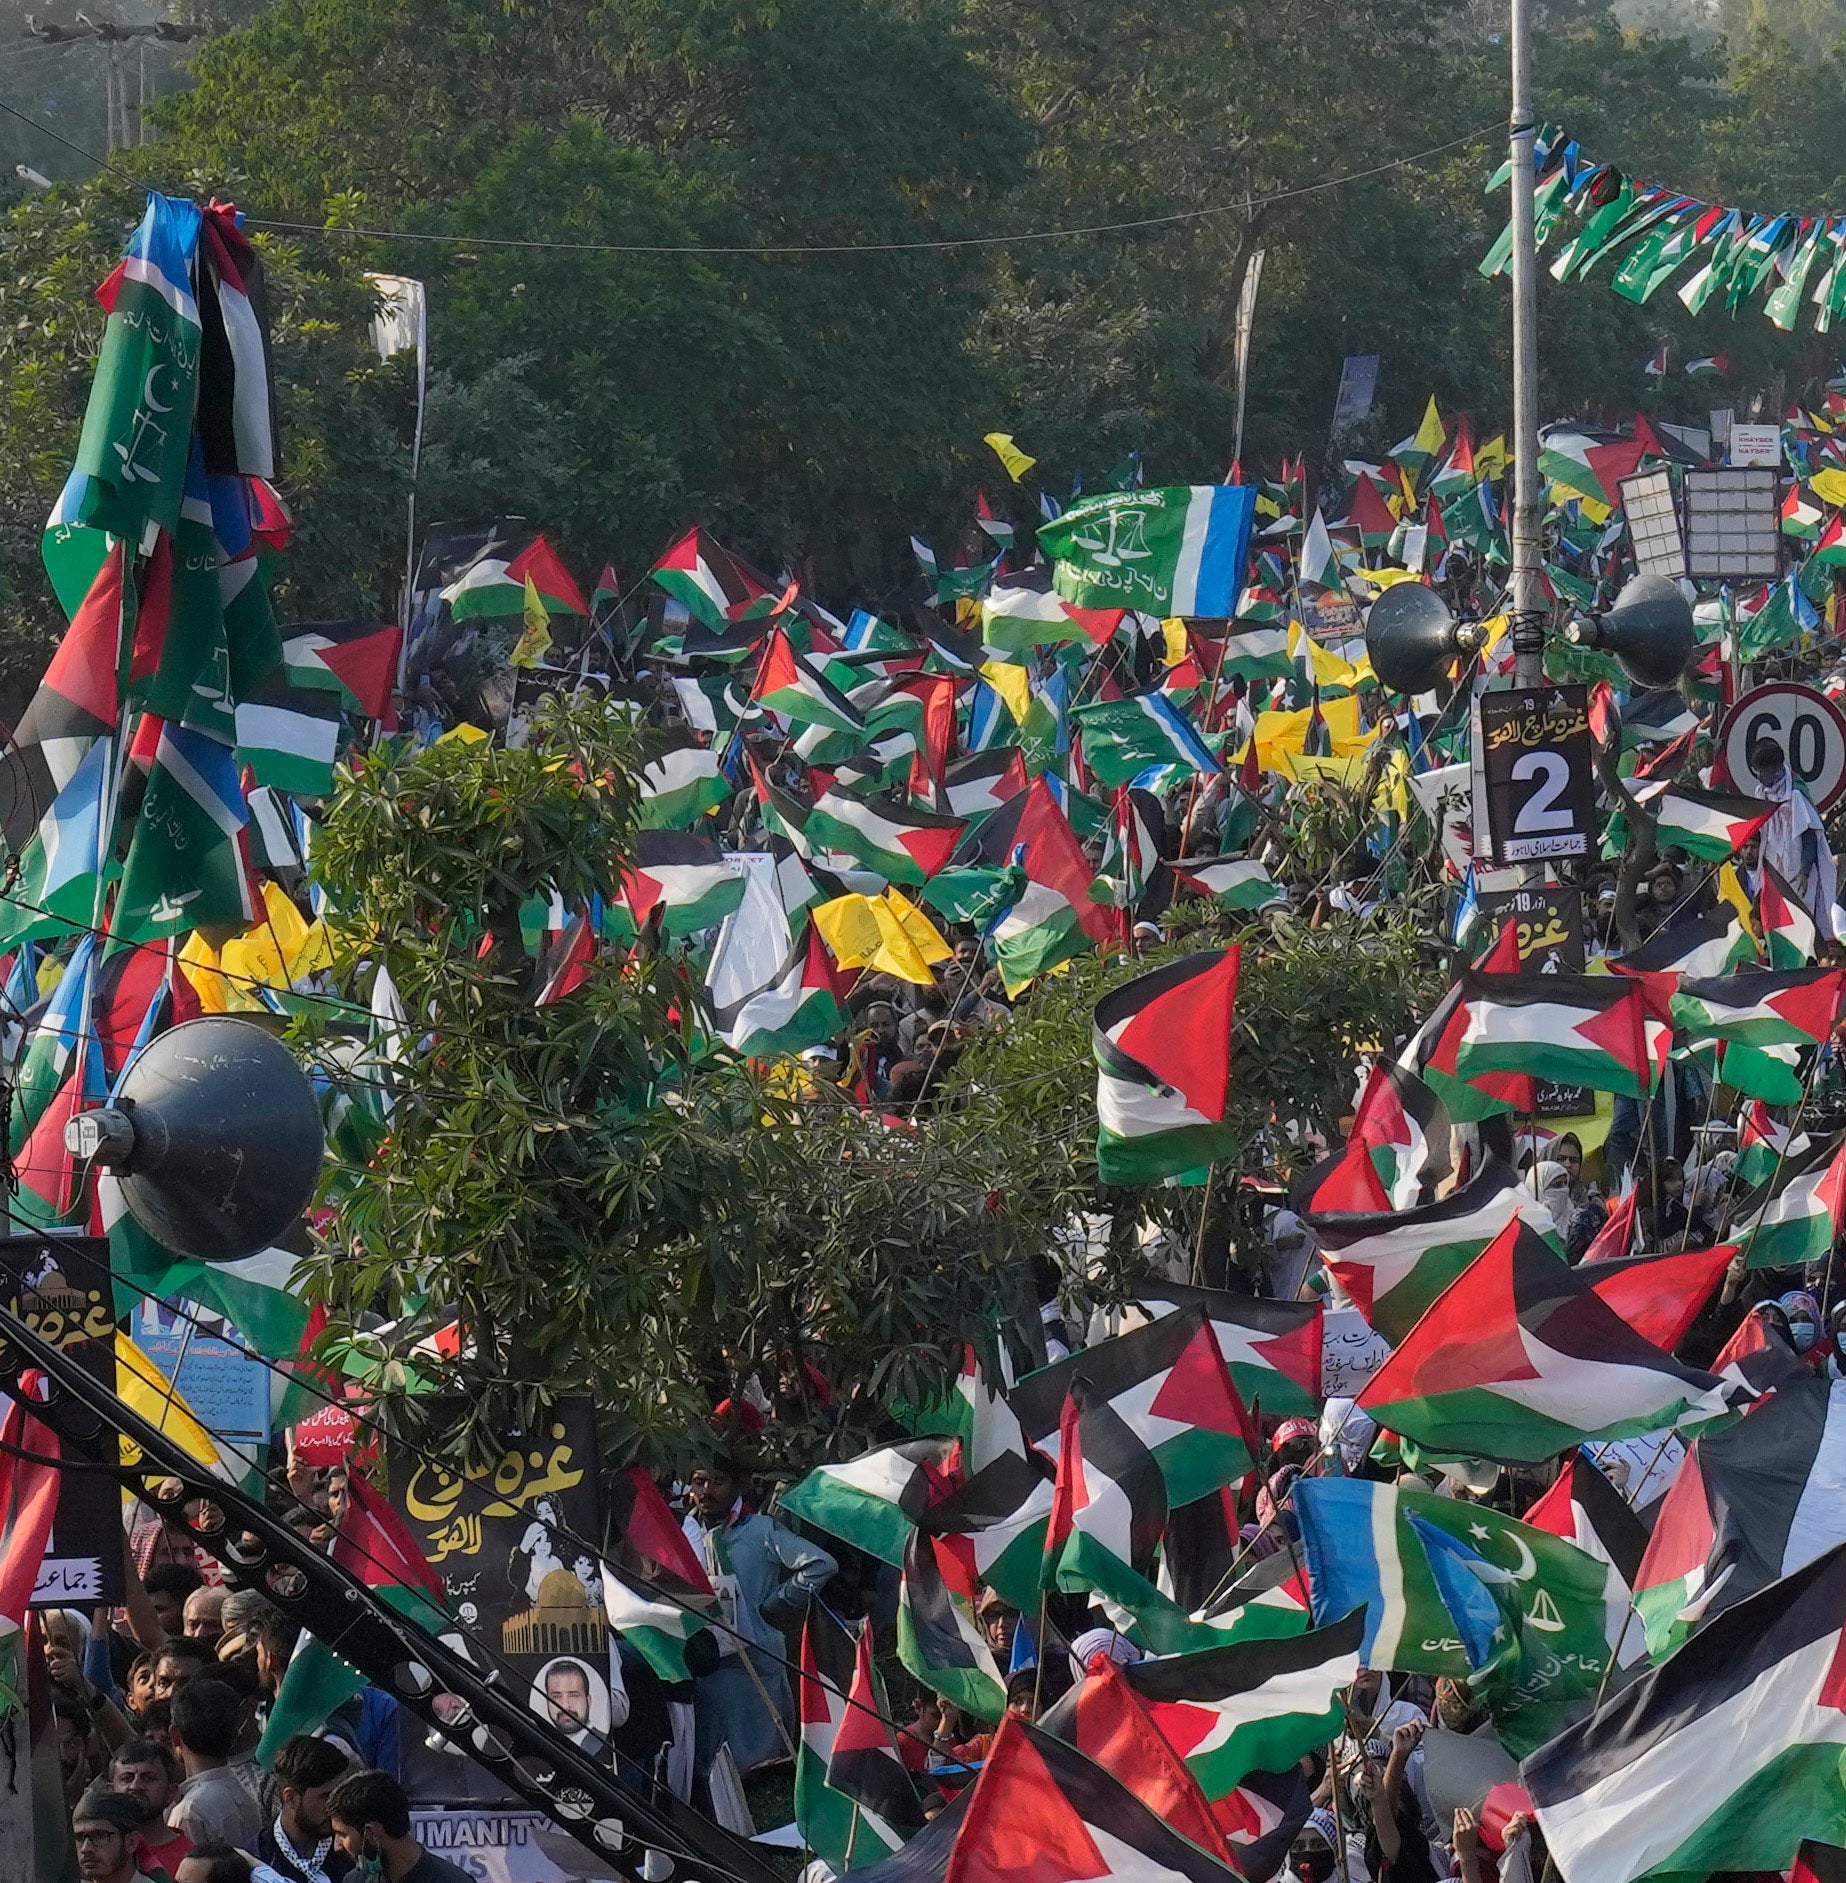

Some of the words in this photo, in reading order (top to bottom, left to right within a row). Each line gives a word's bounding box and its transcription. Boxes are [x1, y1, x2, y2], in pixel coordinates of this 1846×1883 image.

[1523, 698, 1535, 711] 19
[1552, 708, 1589, 743] غزہ
[1486, 719, 1521, 750] لاہور
[1520, 713, 1555, 747] مارچ
[1745, 713, 1826, 783] 60
[1511, 751, 1575, 833] 2
[1514, 892, 1530, 912] 19
[1516, 907, 1570, 961] غزہ
[480, 1422, 585, 1517] غزہ
[425, 1512, 482, 1563] لاہور
